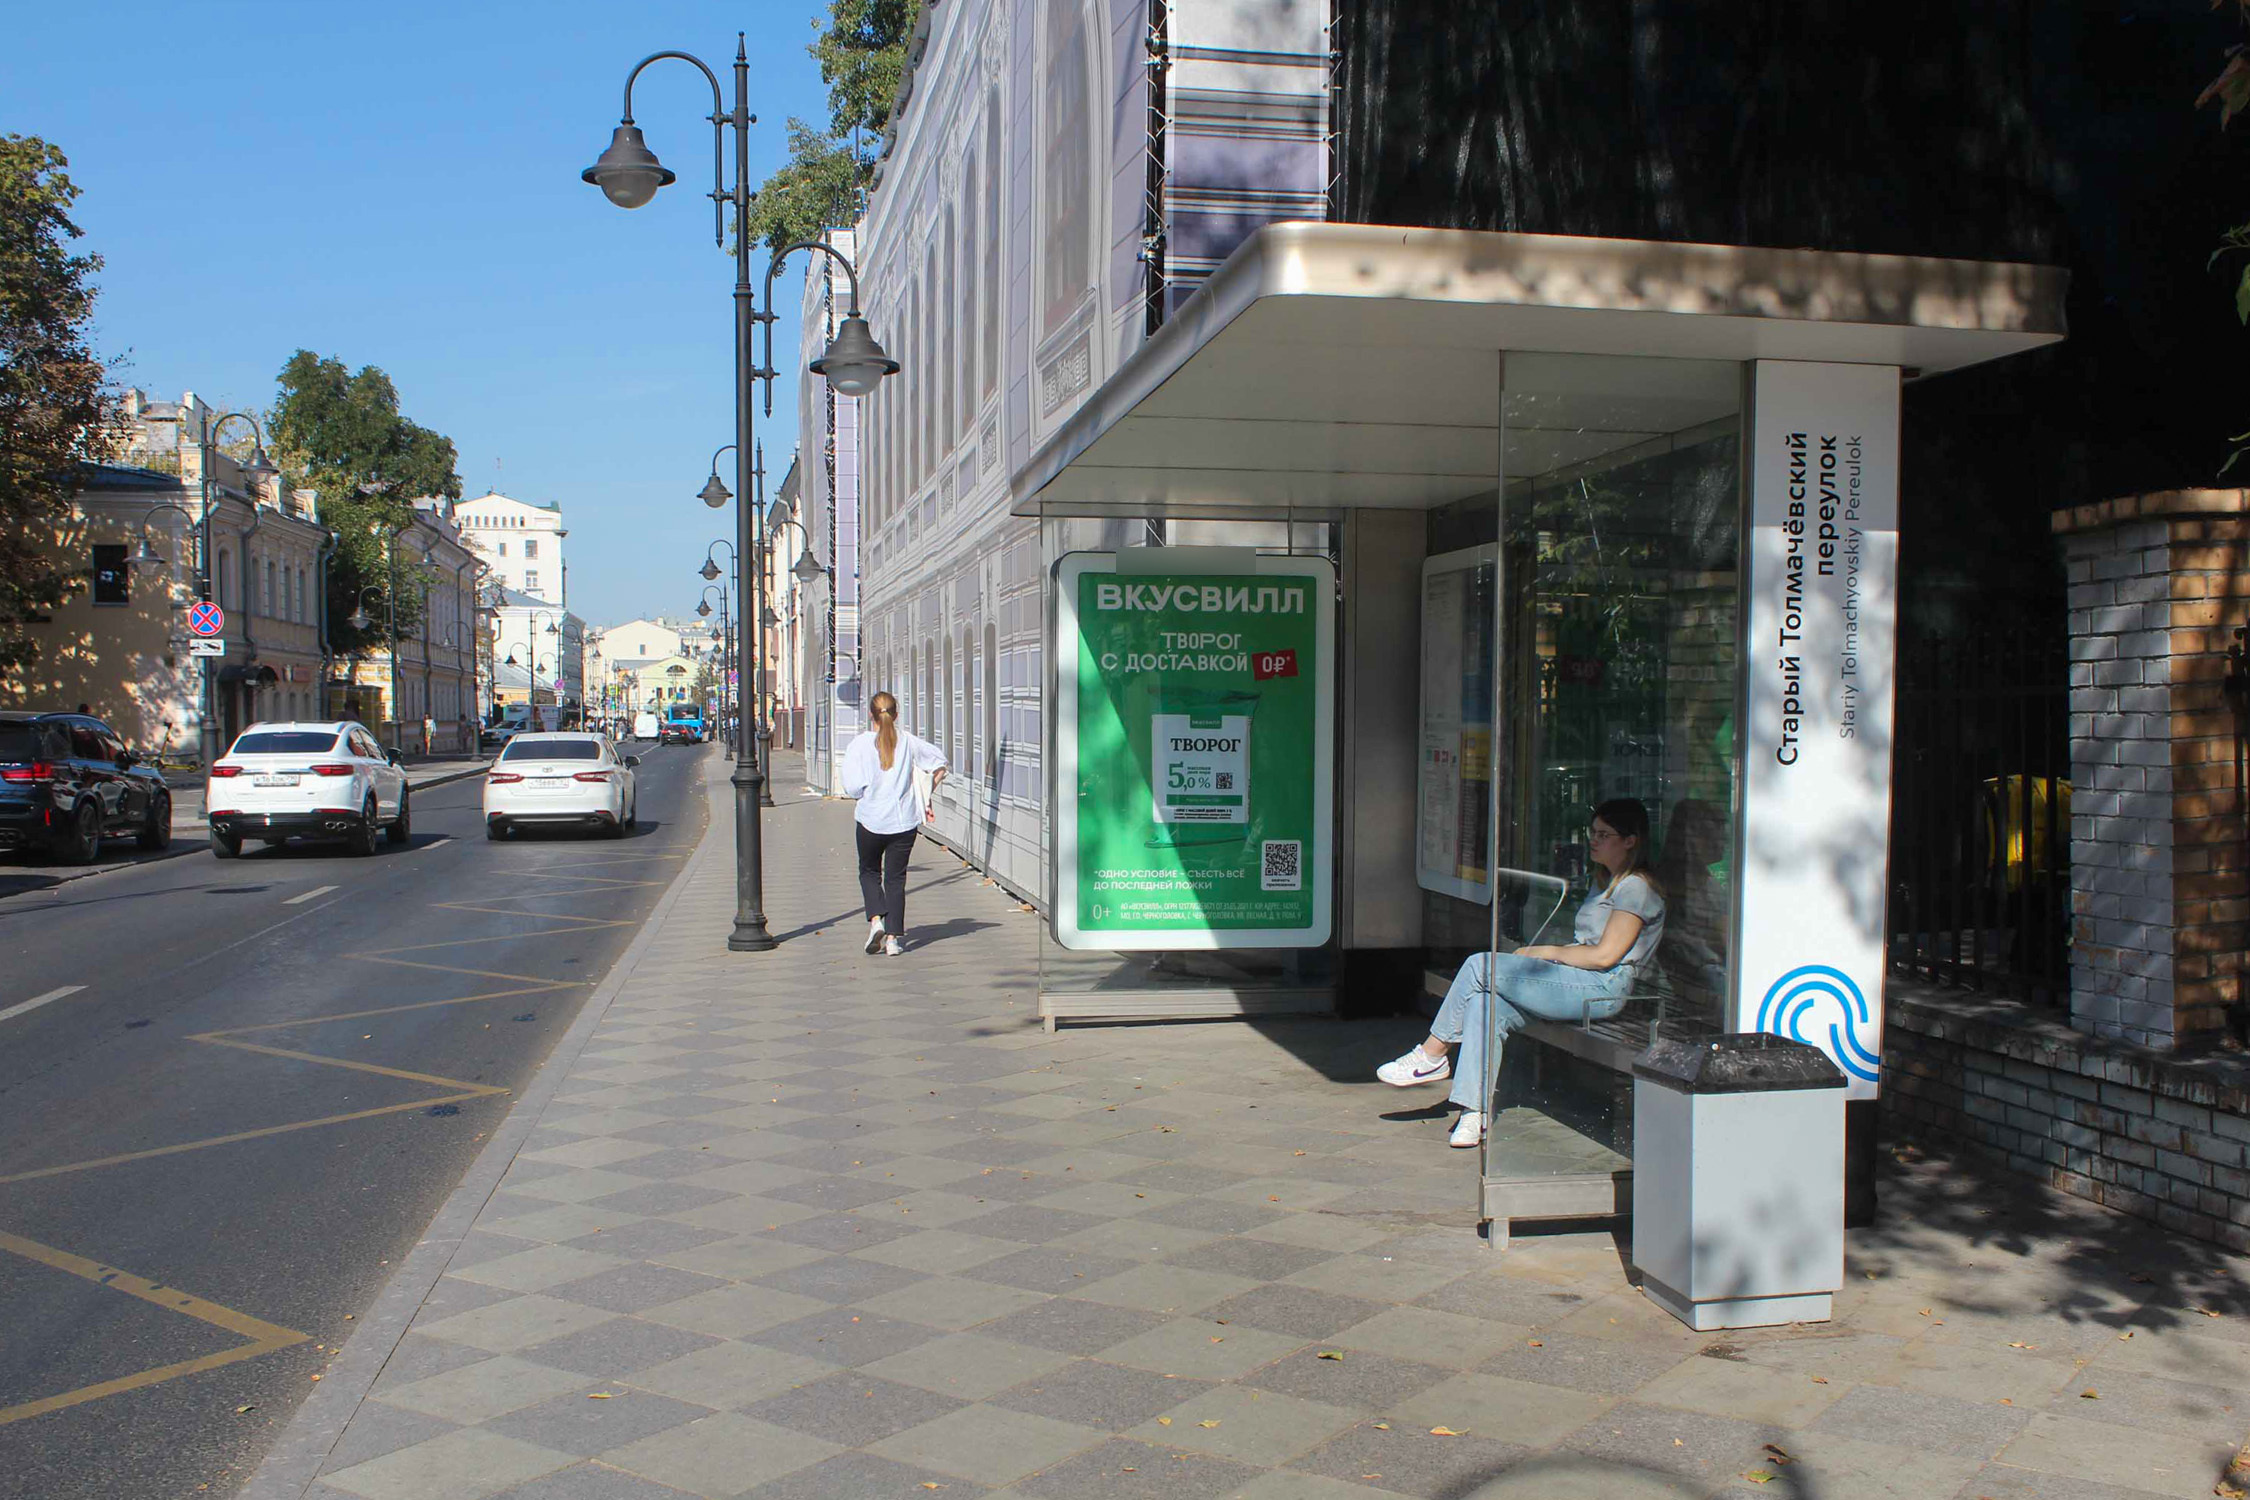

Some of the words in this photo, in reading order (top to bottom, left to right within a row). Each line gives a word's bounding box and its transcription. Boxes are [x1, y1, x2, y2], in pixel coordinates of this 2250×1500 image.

[1845, 435, 1862, 521] Pereulok
[1817, 435, 1840, 576] переулок
[1779, 432, 1807, 648] Толмачёвский
[1097, 584, 1304, 613] ВКУСВИЛЛ
[1842, 527, 1863, 679] Tolmachyovskiy
[1160, 632, 1242, 650] ТВОРОГ
[1101, 653, 1118, 671] С
[1124, 652, 1248, 672] ДОСТАВКОЙ
[1777, 656, 1804, 766] Старый
[1840, 684, 1860, 739] Stariy
[1170, 738, 1241, 752] ТВОРОГ
[1093, 881, 1109, 890] ДО
[1111, 880, 1173, 890] ПОСЛЕДНЕЙ
[1175, 881, 1213, 890] ЛОЖКИ
[1130, 869, 1178, 878] УСЛОВИЕ
[1187, 870, 1225, 878] СЪЕСТЬ
[1226, 868, 1245, 878] ВСЁ
[1092, 904, 1112, 920] 0+
